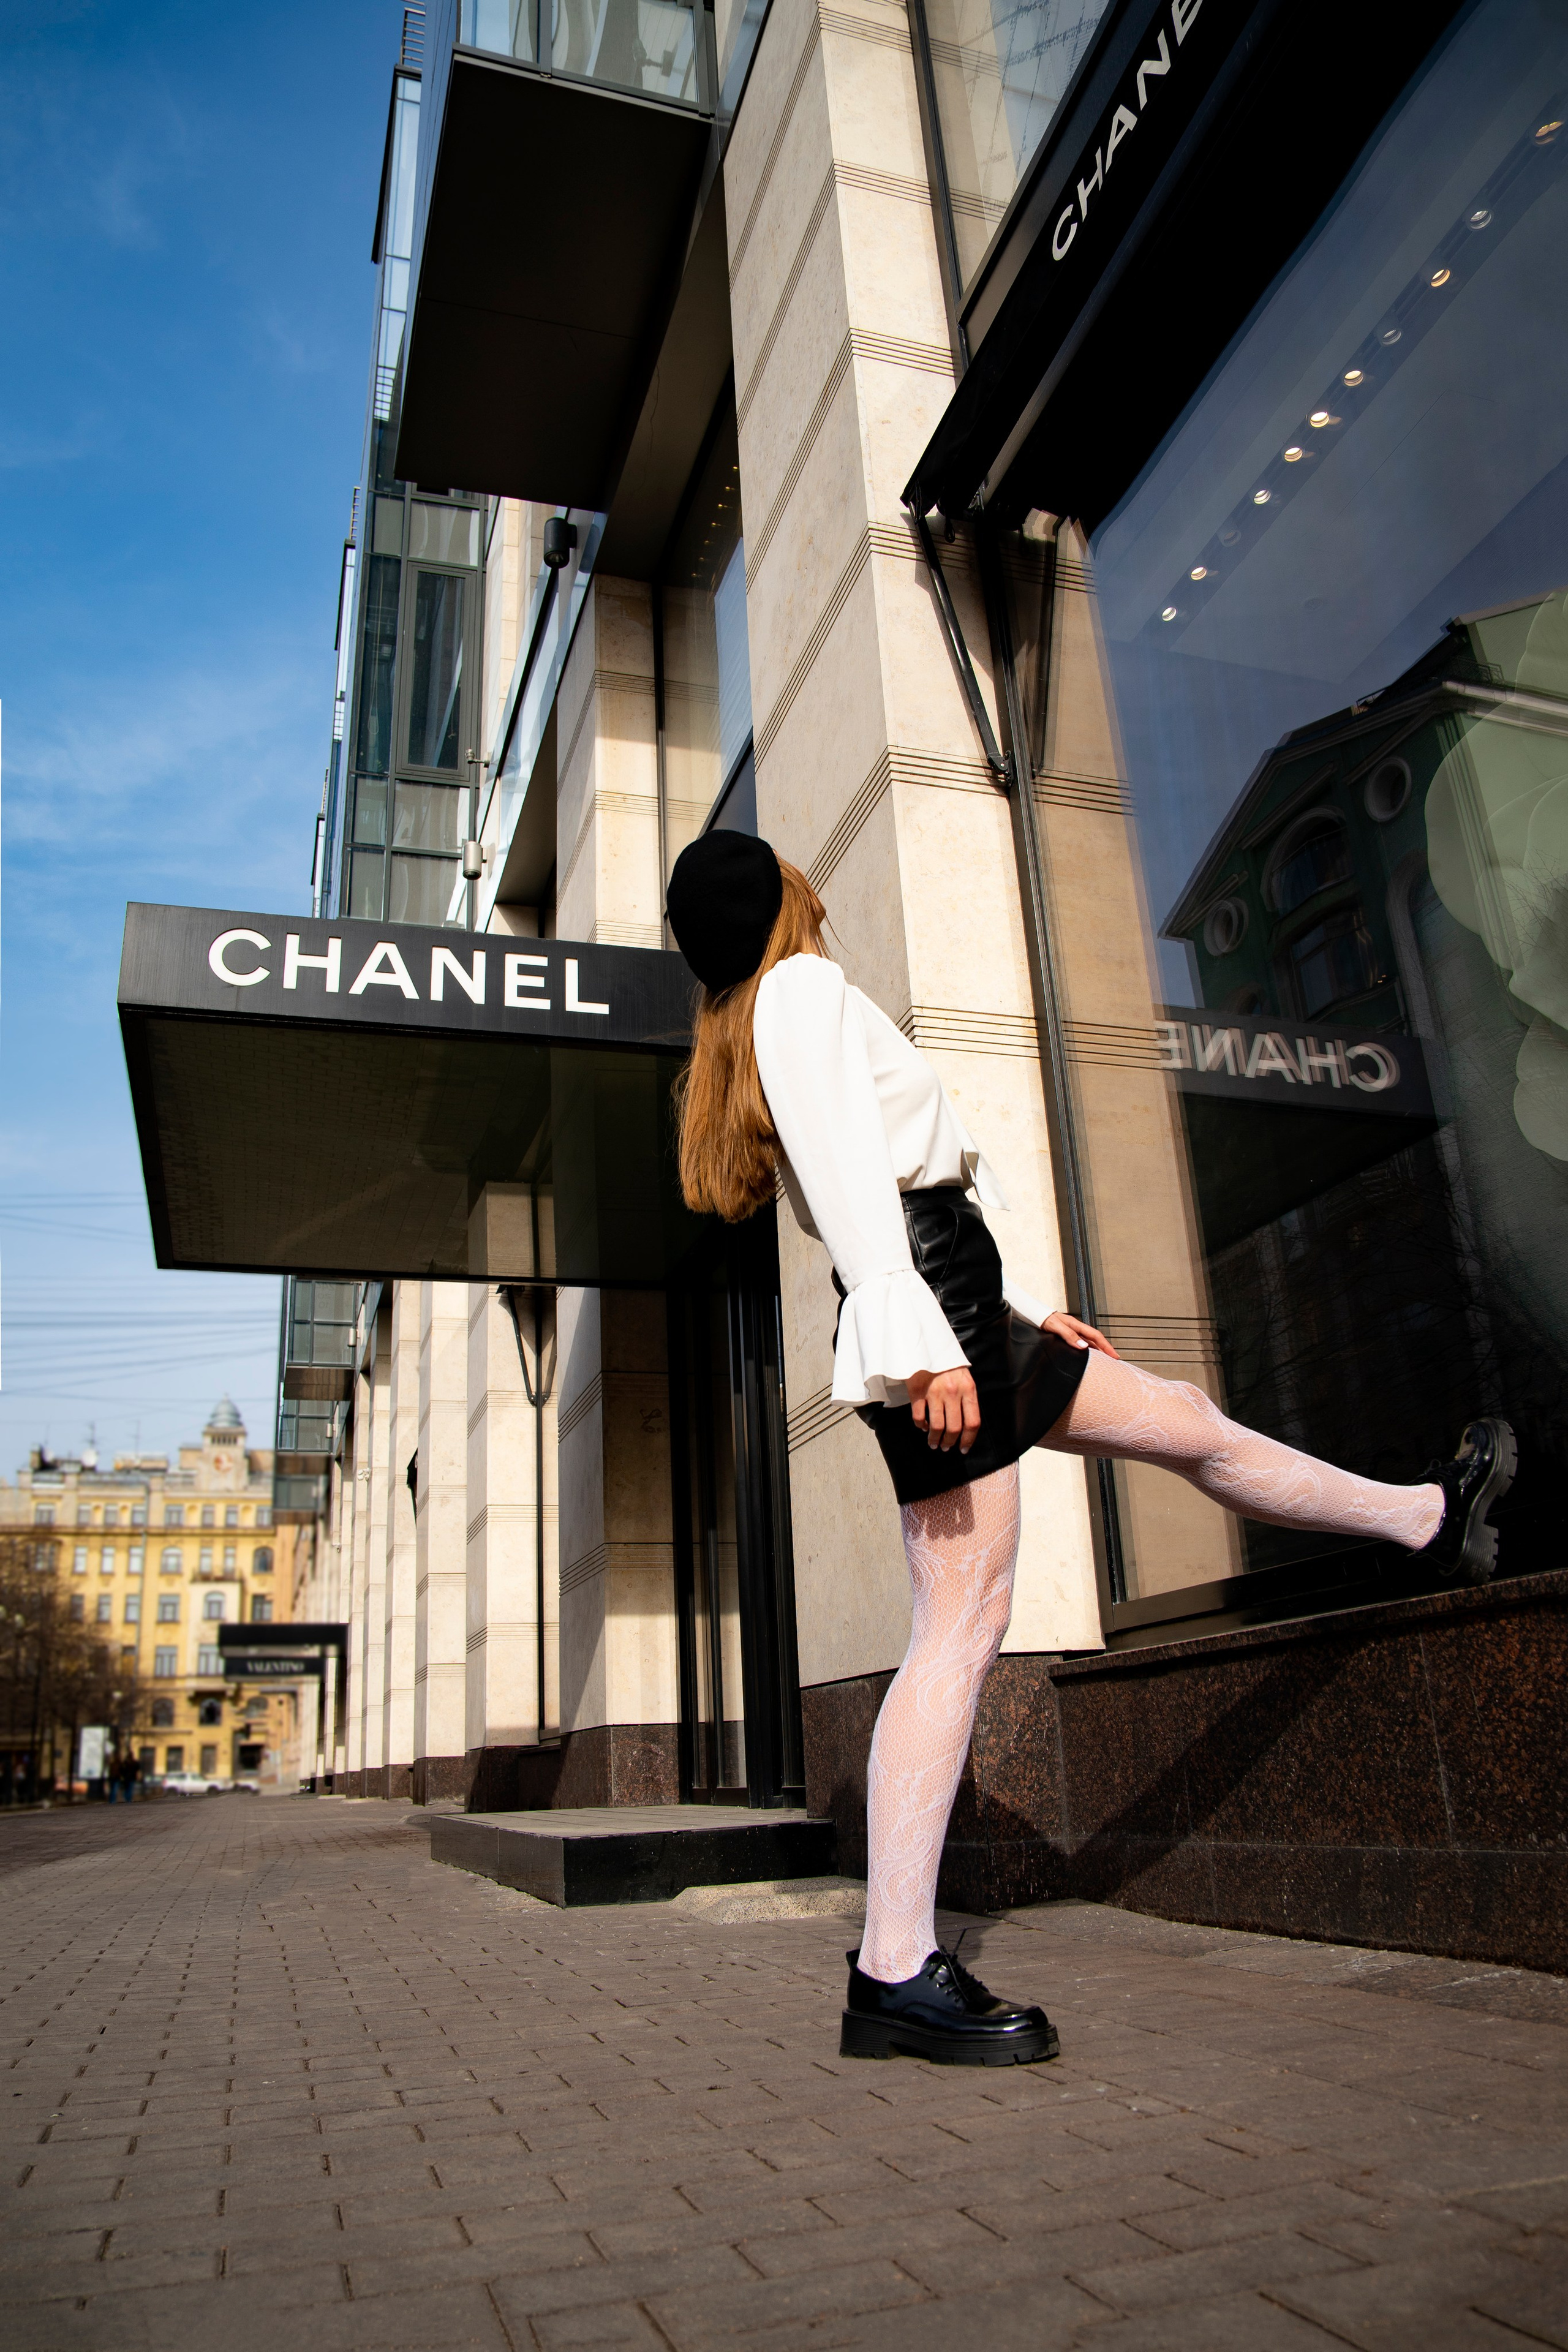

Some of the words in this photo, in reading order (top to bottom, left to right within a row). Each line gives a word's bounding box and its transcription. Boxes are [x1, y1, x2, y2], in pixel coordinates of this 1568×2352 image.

[1052, 0, 1204, 261] CHANE
[208, 927, 610, 1015] CHANEL
[246, 1660, 305, 1673] VALENTINO
